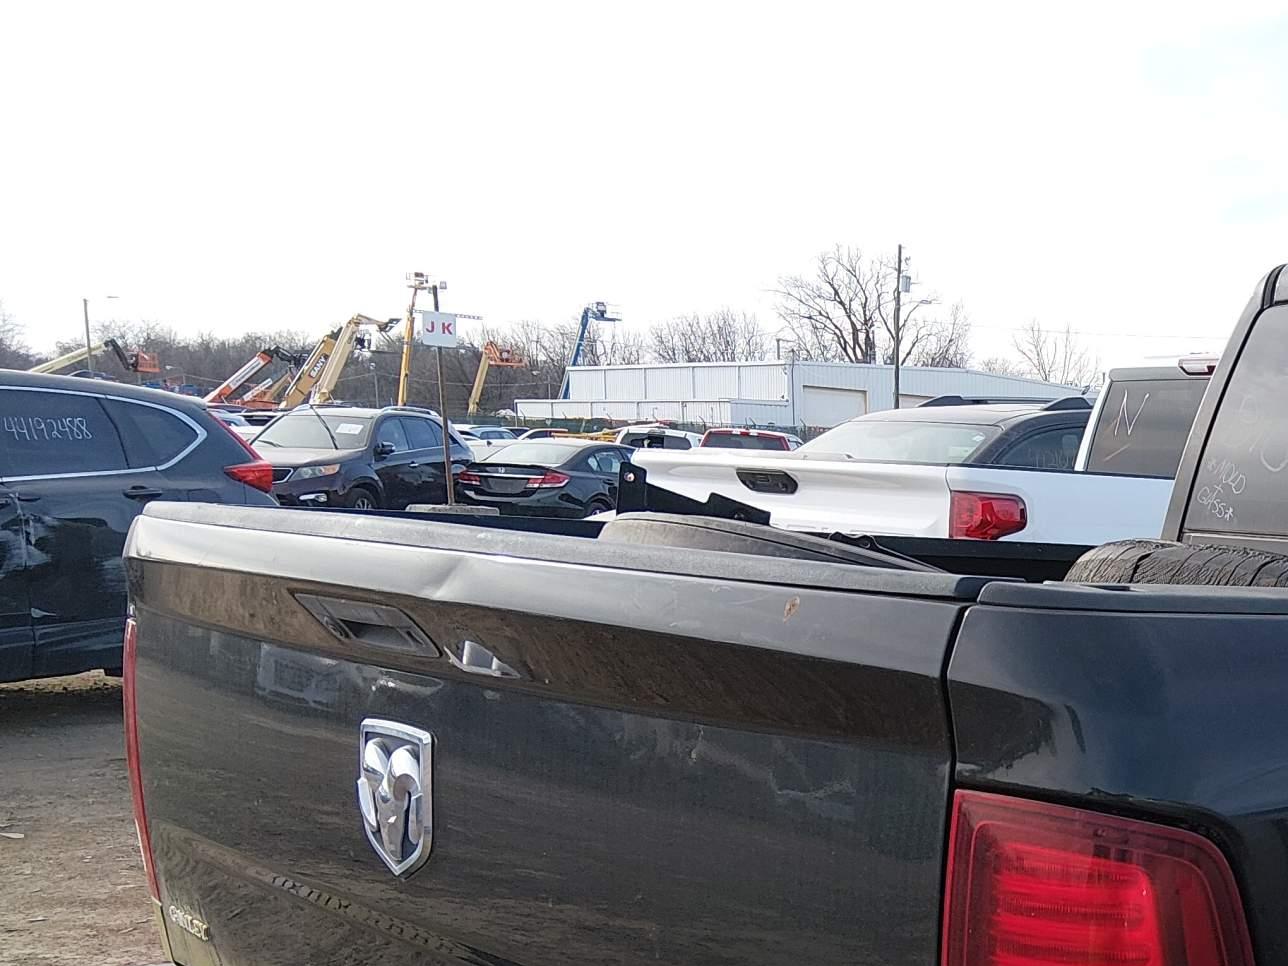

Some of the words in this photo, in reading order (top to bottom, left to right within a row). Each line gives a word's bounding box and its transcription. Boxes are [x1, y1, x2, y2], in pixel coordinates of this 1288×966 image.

[425, 320, 435, 333] J
[441, 322, 453, 335] K
[310, 355, 327, 378] SANY
[1114, 389, 1150, 436] N
[3, 417, 93, 440] 44192488
